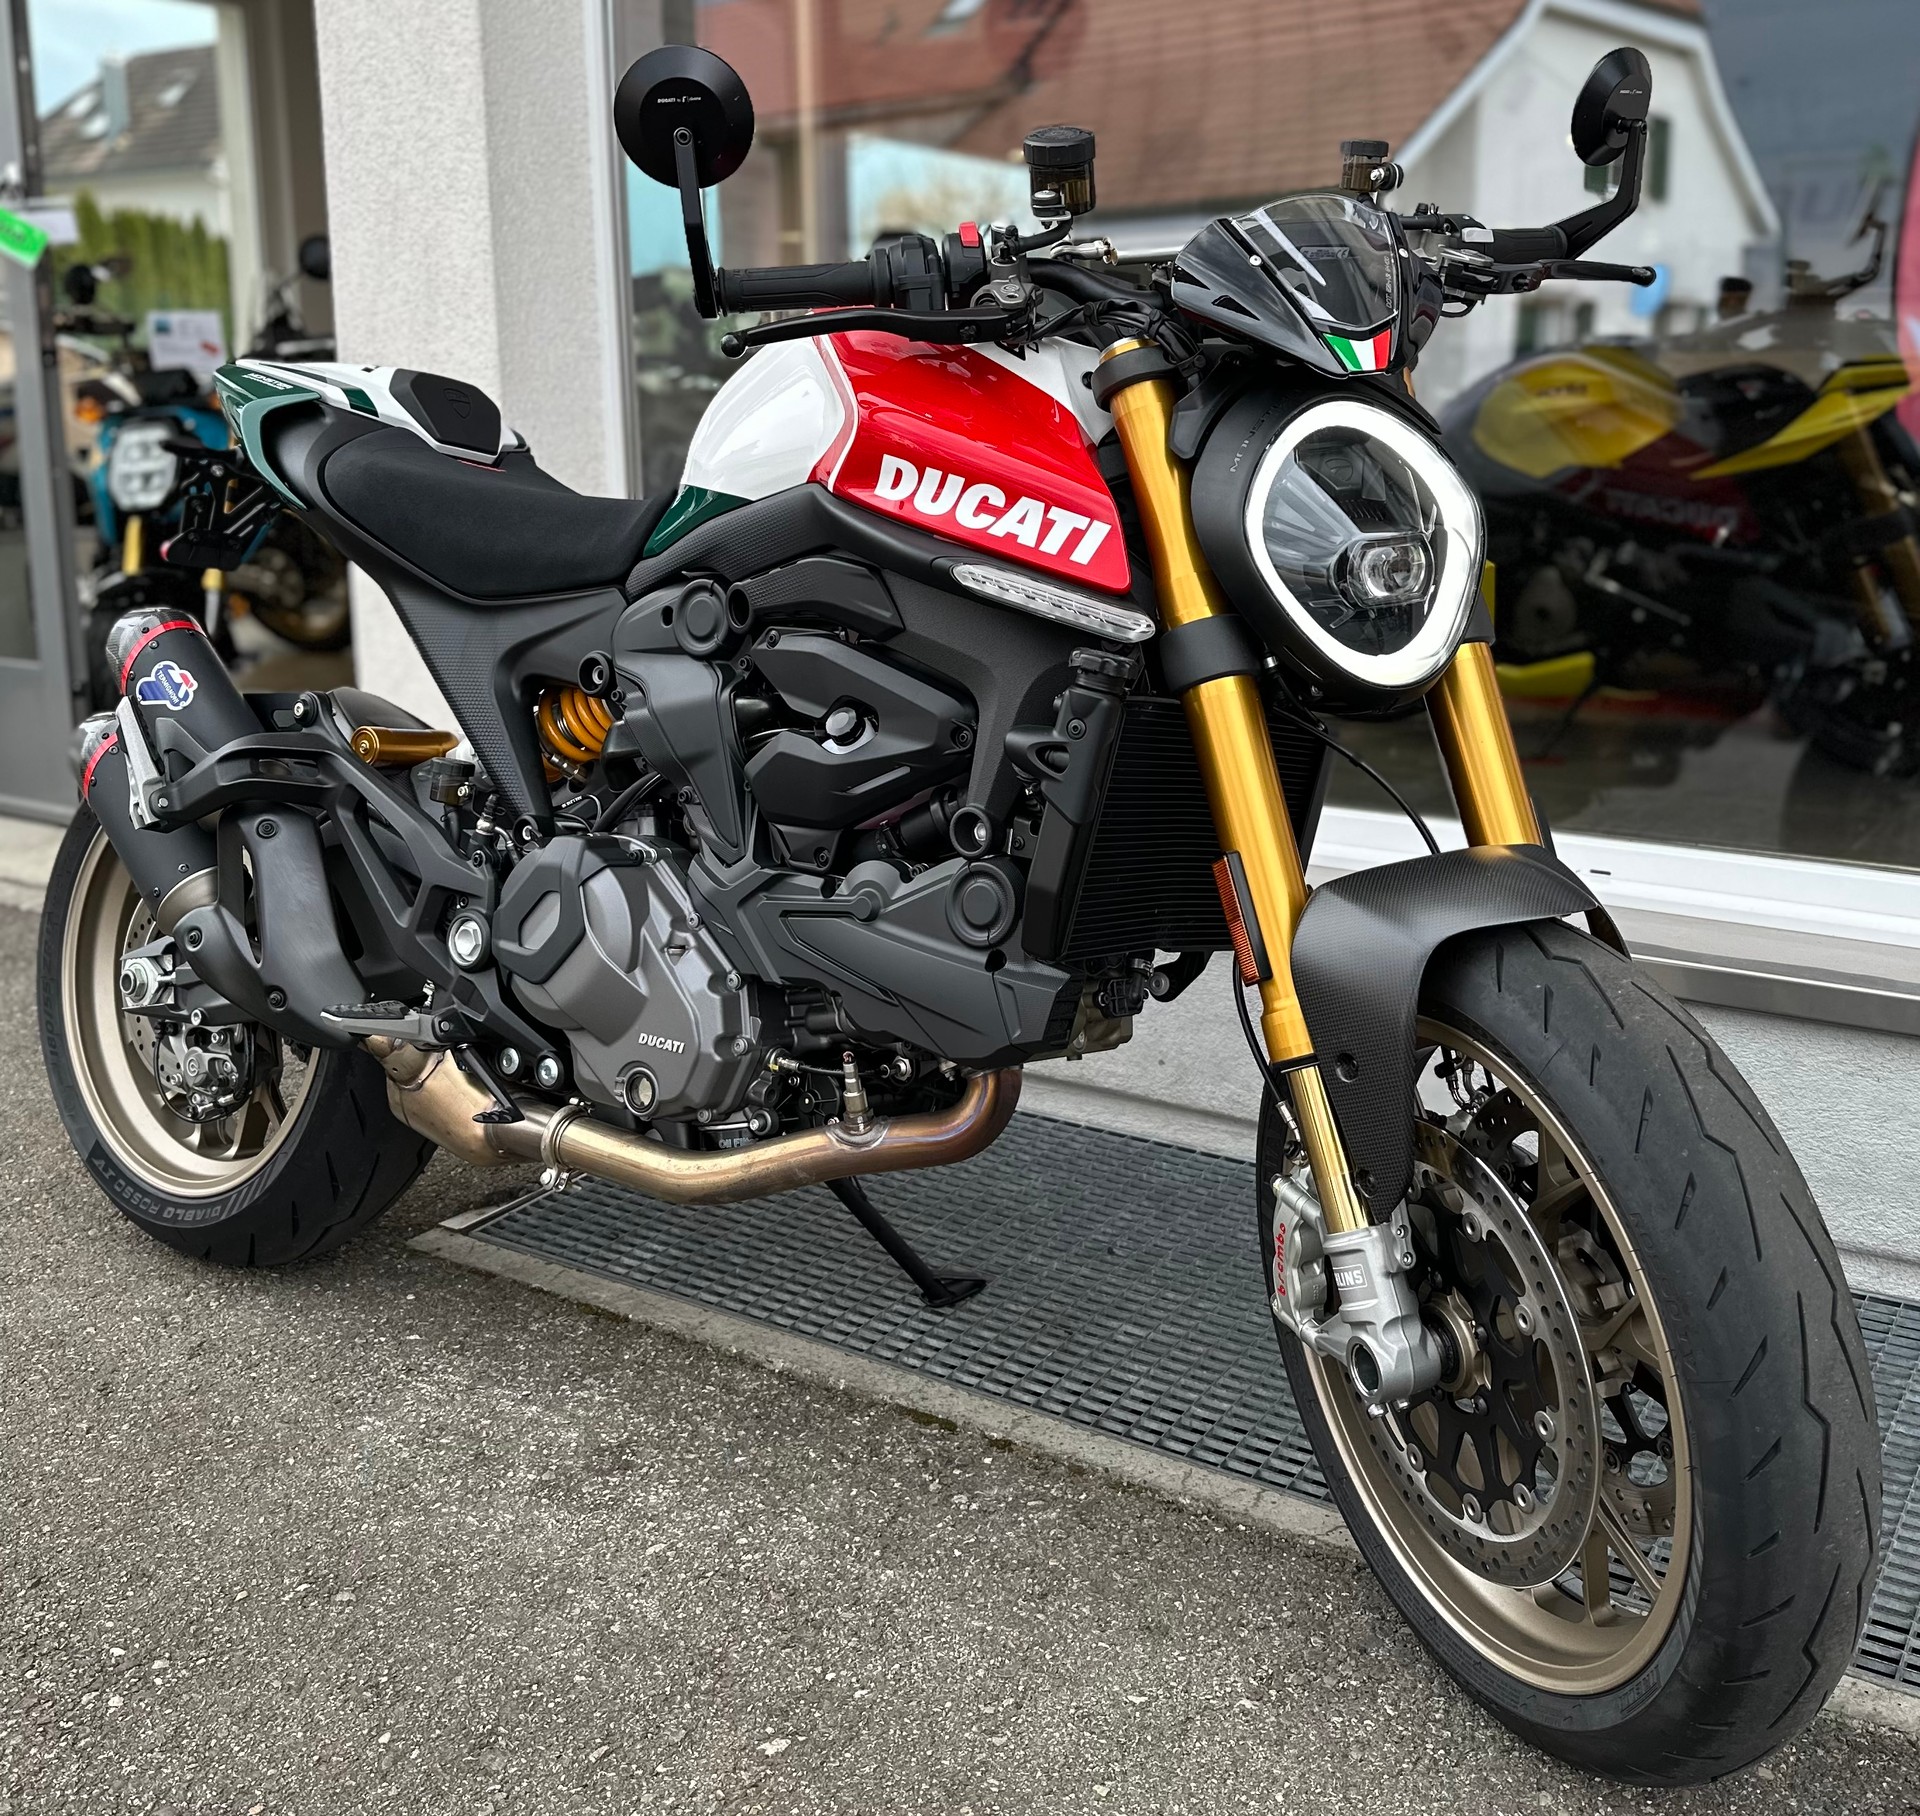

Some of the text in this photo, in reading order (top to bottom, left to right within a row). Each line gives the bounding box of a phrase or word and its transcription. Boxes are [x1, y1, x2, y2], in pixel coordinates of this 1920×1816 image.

[873, 453, 1112, 565] DUCATI
[638, 1032, 686, 1054] DUCATI
[91, 1157, 222, 1221] DIABLO ROSSO IV
[1275, 1222, 1287, 1297] brembo
